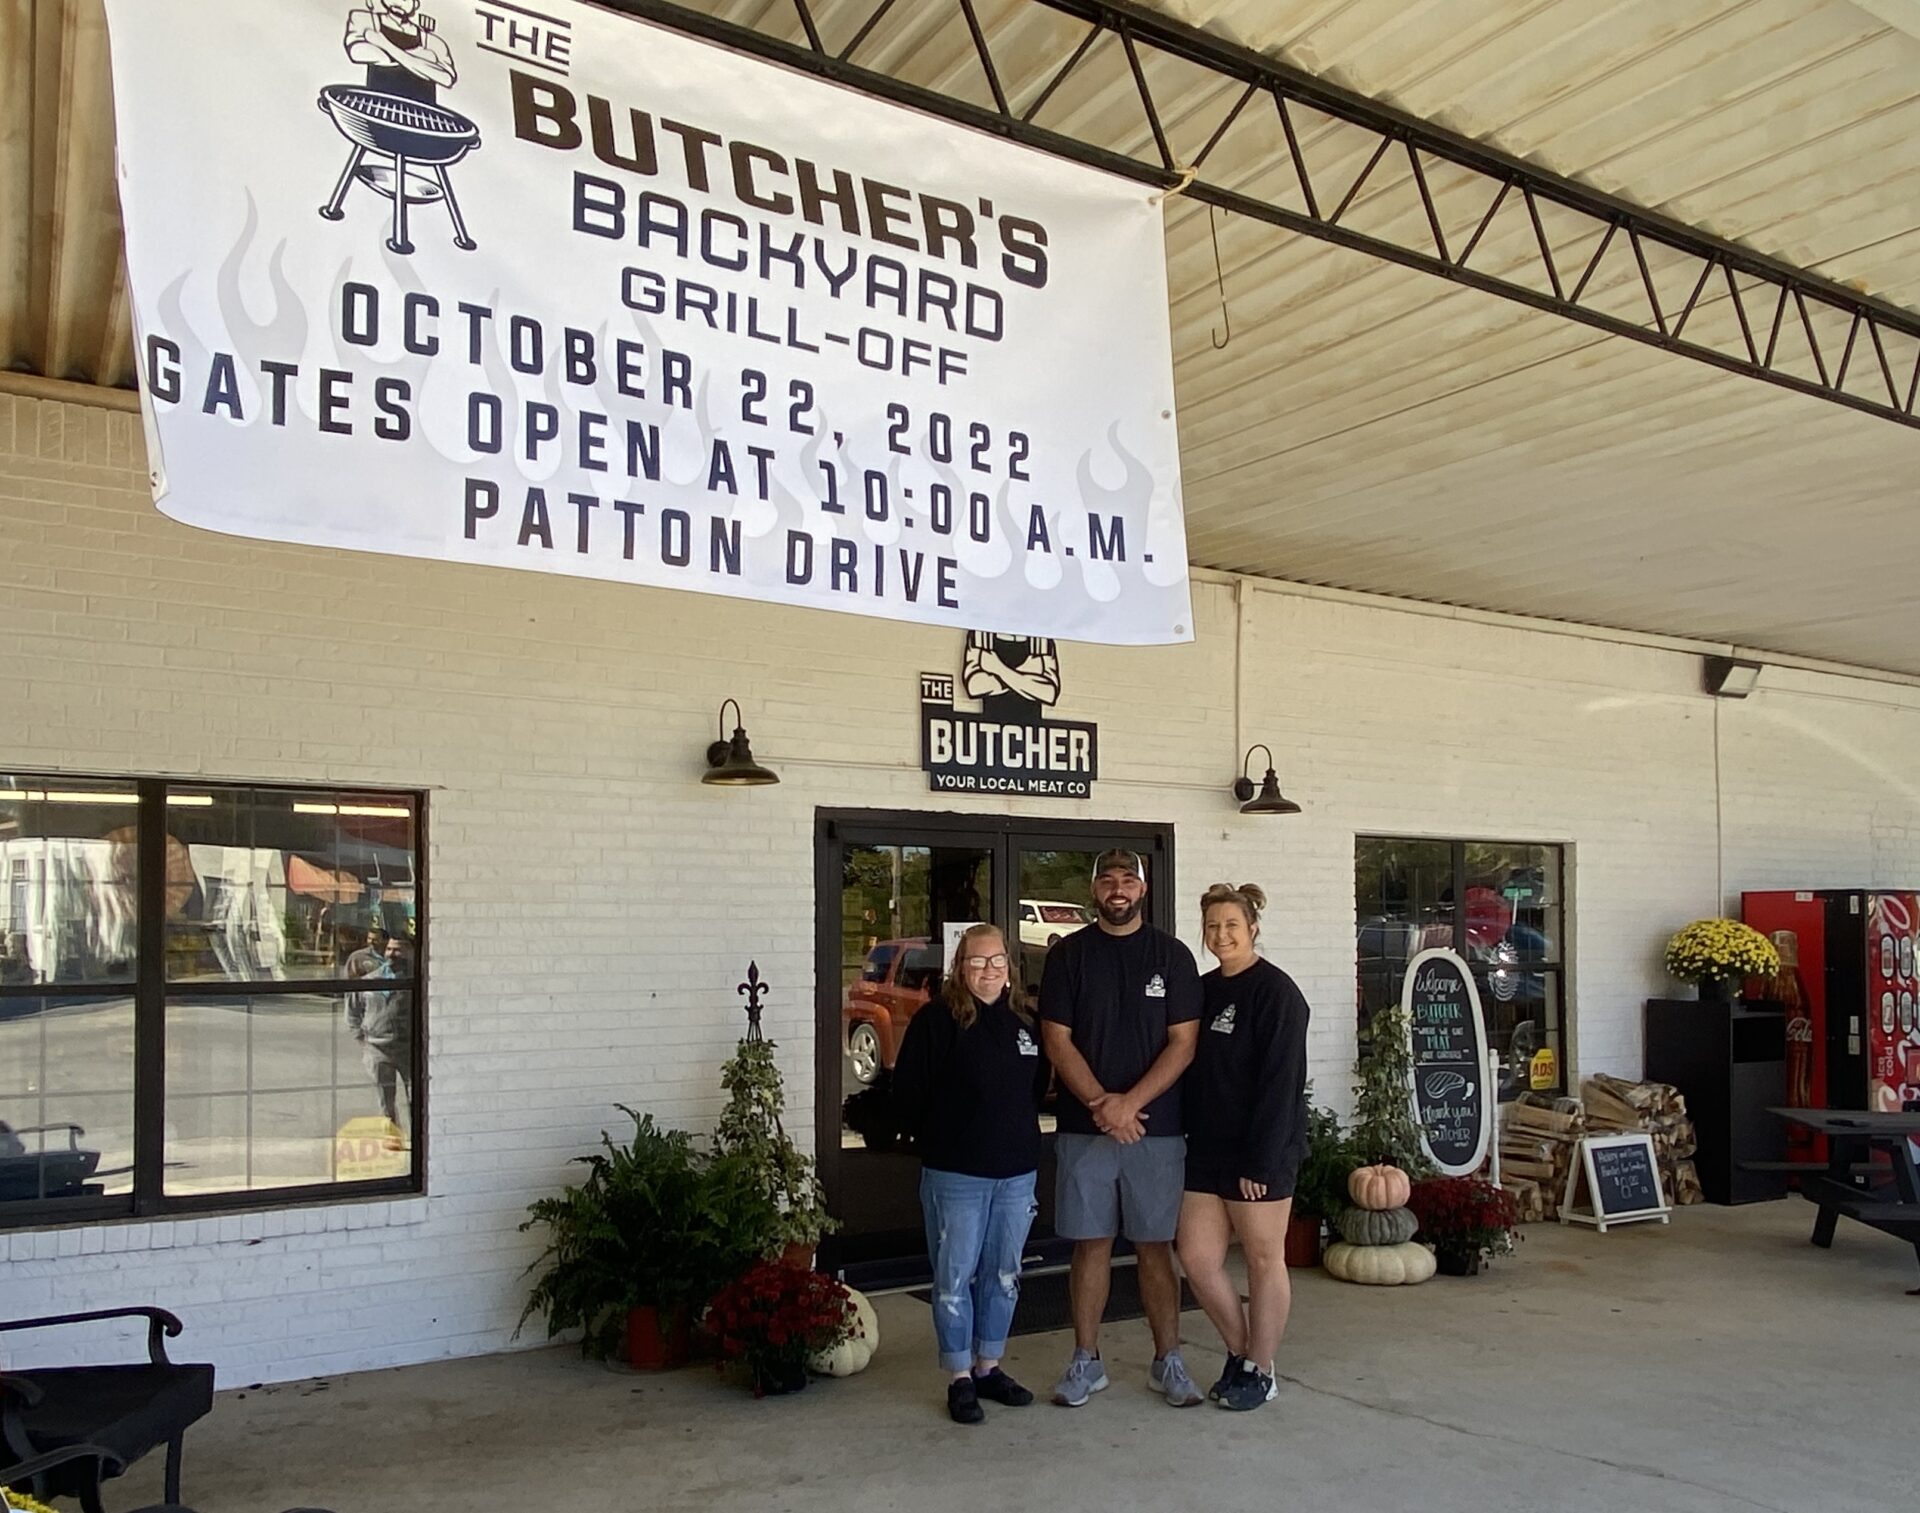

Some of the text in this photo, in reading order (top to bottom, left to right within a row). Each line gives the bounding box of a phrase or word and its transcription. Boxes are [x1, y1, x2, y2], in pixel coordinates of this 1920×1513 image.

[476, 9, 570, 66] THE
[509, 69, 1049, 289] BUTCHER'S
[572, 171, 1004, 342] BACKYARD
[622, 266, 968, 385] GRILL-OFF
[342, 282, 1030, 482] OCTOBER 22, 2022
[147, 334, 1154, 563] GATES OPEN AT 10:00 A.M.
[464, 477, 959, 609] PATTON DRIVE
[922, 681, 953, 698] THE
[930, 719, 1091, 773] BUTCHER
[937, 774, 1086, 794] YOUR LOCAL MEAT CO
[1415, 968, 1463, 994] Welcome
[1532, 1062, 1553, 1077] ADS
